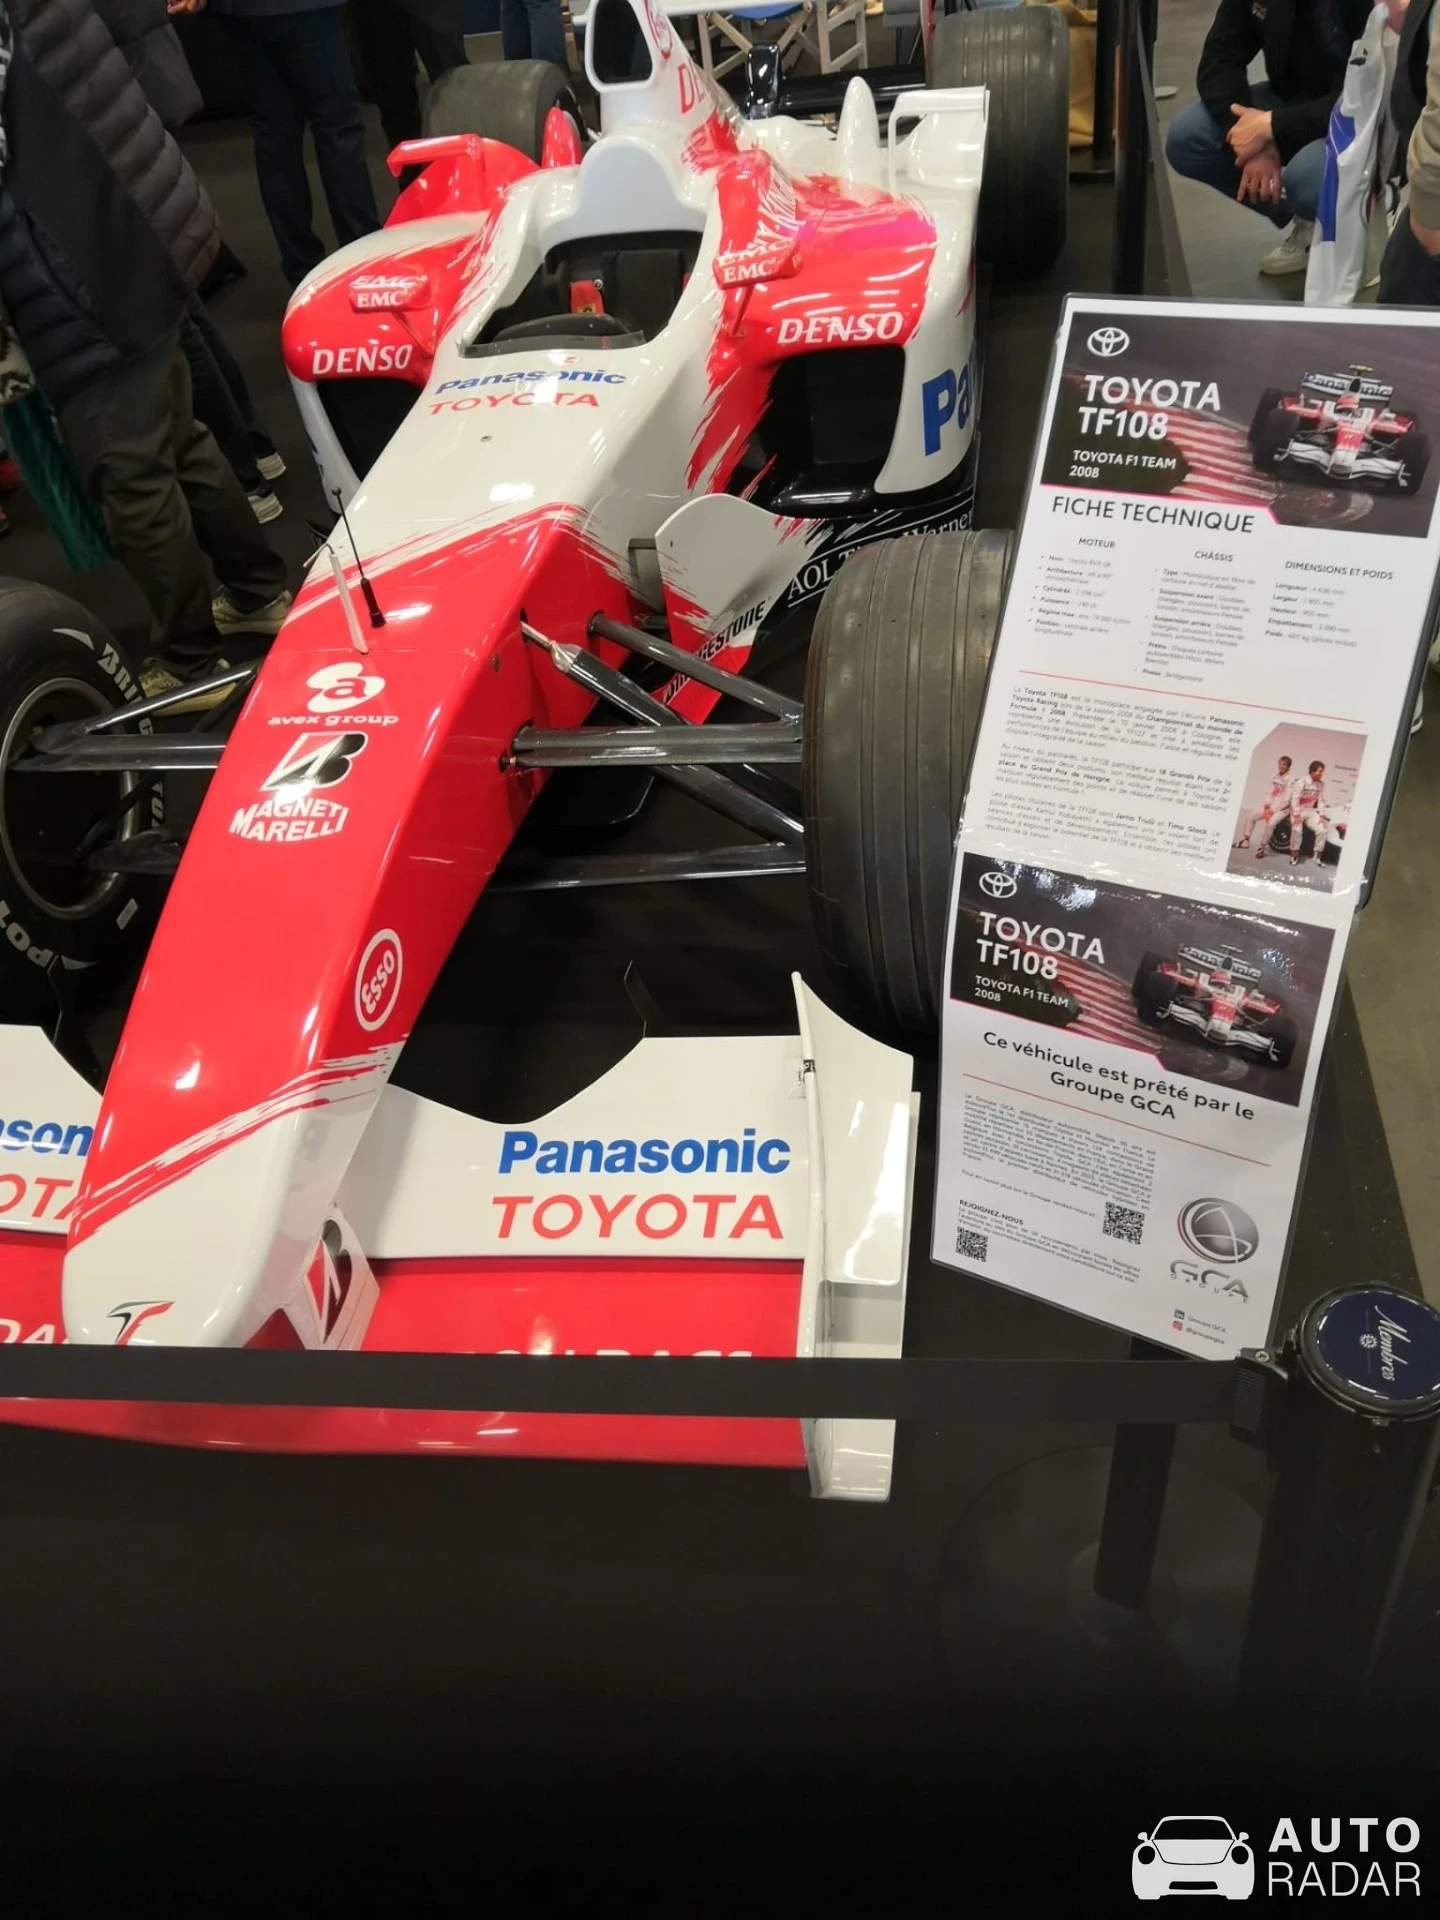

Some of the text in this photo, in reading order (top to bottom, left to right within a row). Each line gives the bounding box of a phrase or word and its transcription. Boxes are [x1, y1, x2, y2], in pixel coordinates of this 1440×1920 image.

[777, 312, 903, 344] DENSO
[312, 344, 413, 375] DENSO
[435, 369, 627, 395] Panasonic
[1084, 374, 1221, 411] TOYOTA
[429, 392, 600, 416] TOYOTA
[922, 363, 972, 456] Pa
[1078, 406, 1168, 440] TF108
[1069, 465, 1100, 478] 2008
[1072, 449, 1177, 469] TOYOTA F1 TEAM
[1052, 496, 1255, 533] FICHE TECHNIQUE
[1078, 537, 1116, 548] MOTEUR
[787, 557, 836, 600] AOL
[1285, 560, 1394, 580] DIMENSIONS ET POIDS
[267, 714, 399, 727] avex group
[229, 797, 349, 834] MAGNETI
[229, 812, 349, 842] MARELLI
[979, 910, 1105, 964] TOYOTA
[976, 938, 1058, 980] TF108
[974, 987, 1001, 1002] 2008
[975, 975, 1069, 1008] TOYOTA F1 TEAM
[983, 1031, 1255, 1120] Ce véhicule est prêté par le
[1050, 1071, 1176, 1119] Groupe GCA
[0, 1118, 94, 1157] son
[498, 1128, 791, 1174] Panasonic
[492, 1193, 784, 1240] TOYOTA
[959, 1199, 1024, 1225] REJOIGNEZ-NOUS
[1170, 1260, 1249, 1299] GCA
[1374, 1304, 1411, 1381] Membres
